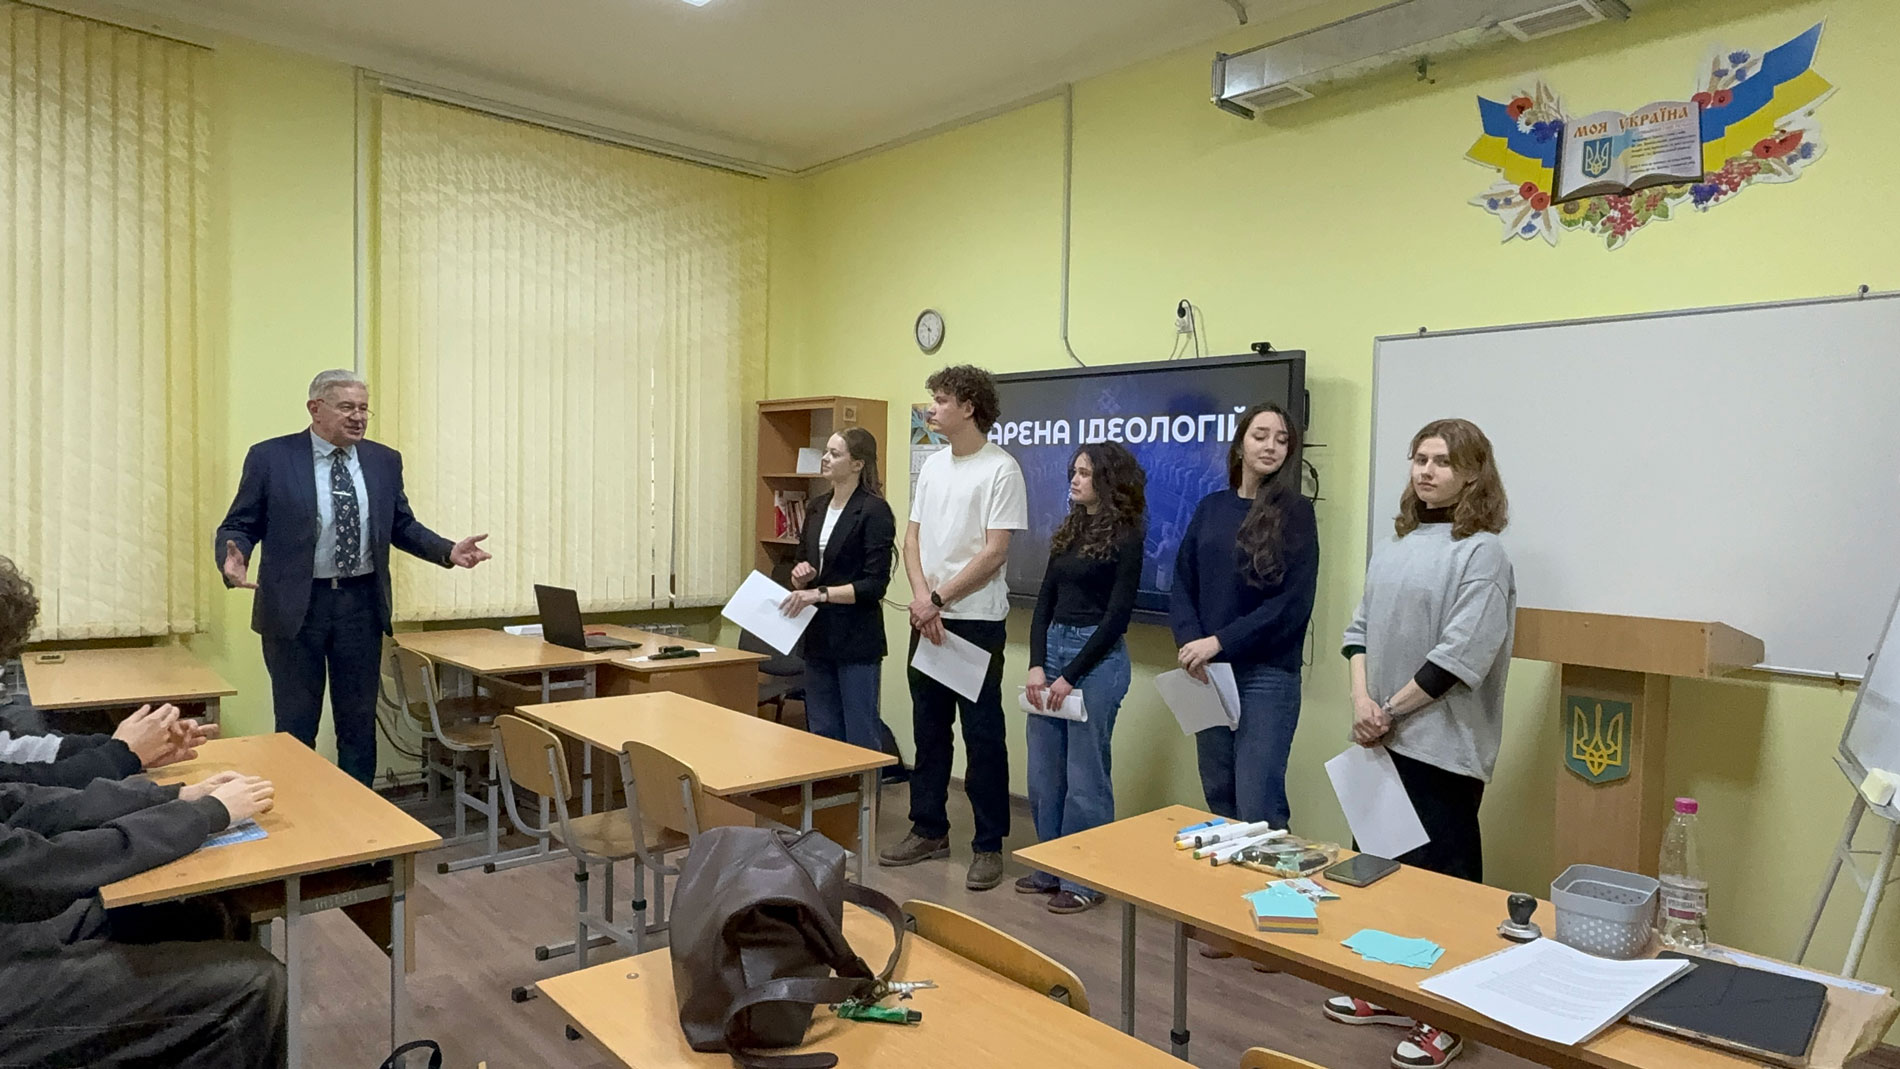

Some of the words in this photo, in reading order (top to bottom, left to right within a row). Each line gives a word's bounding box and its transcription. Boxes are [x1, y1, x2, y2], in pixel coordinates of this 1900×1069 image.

[1574, 121, 1608, 138] МОЯ
[1618, 106, 1689, 132] УКРАЇНА
[987, 420, 1070, 446] АРЕНА
